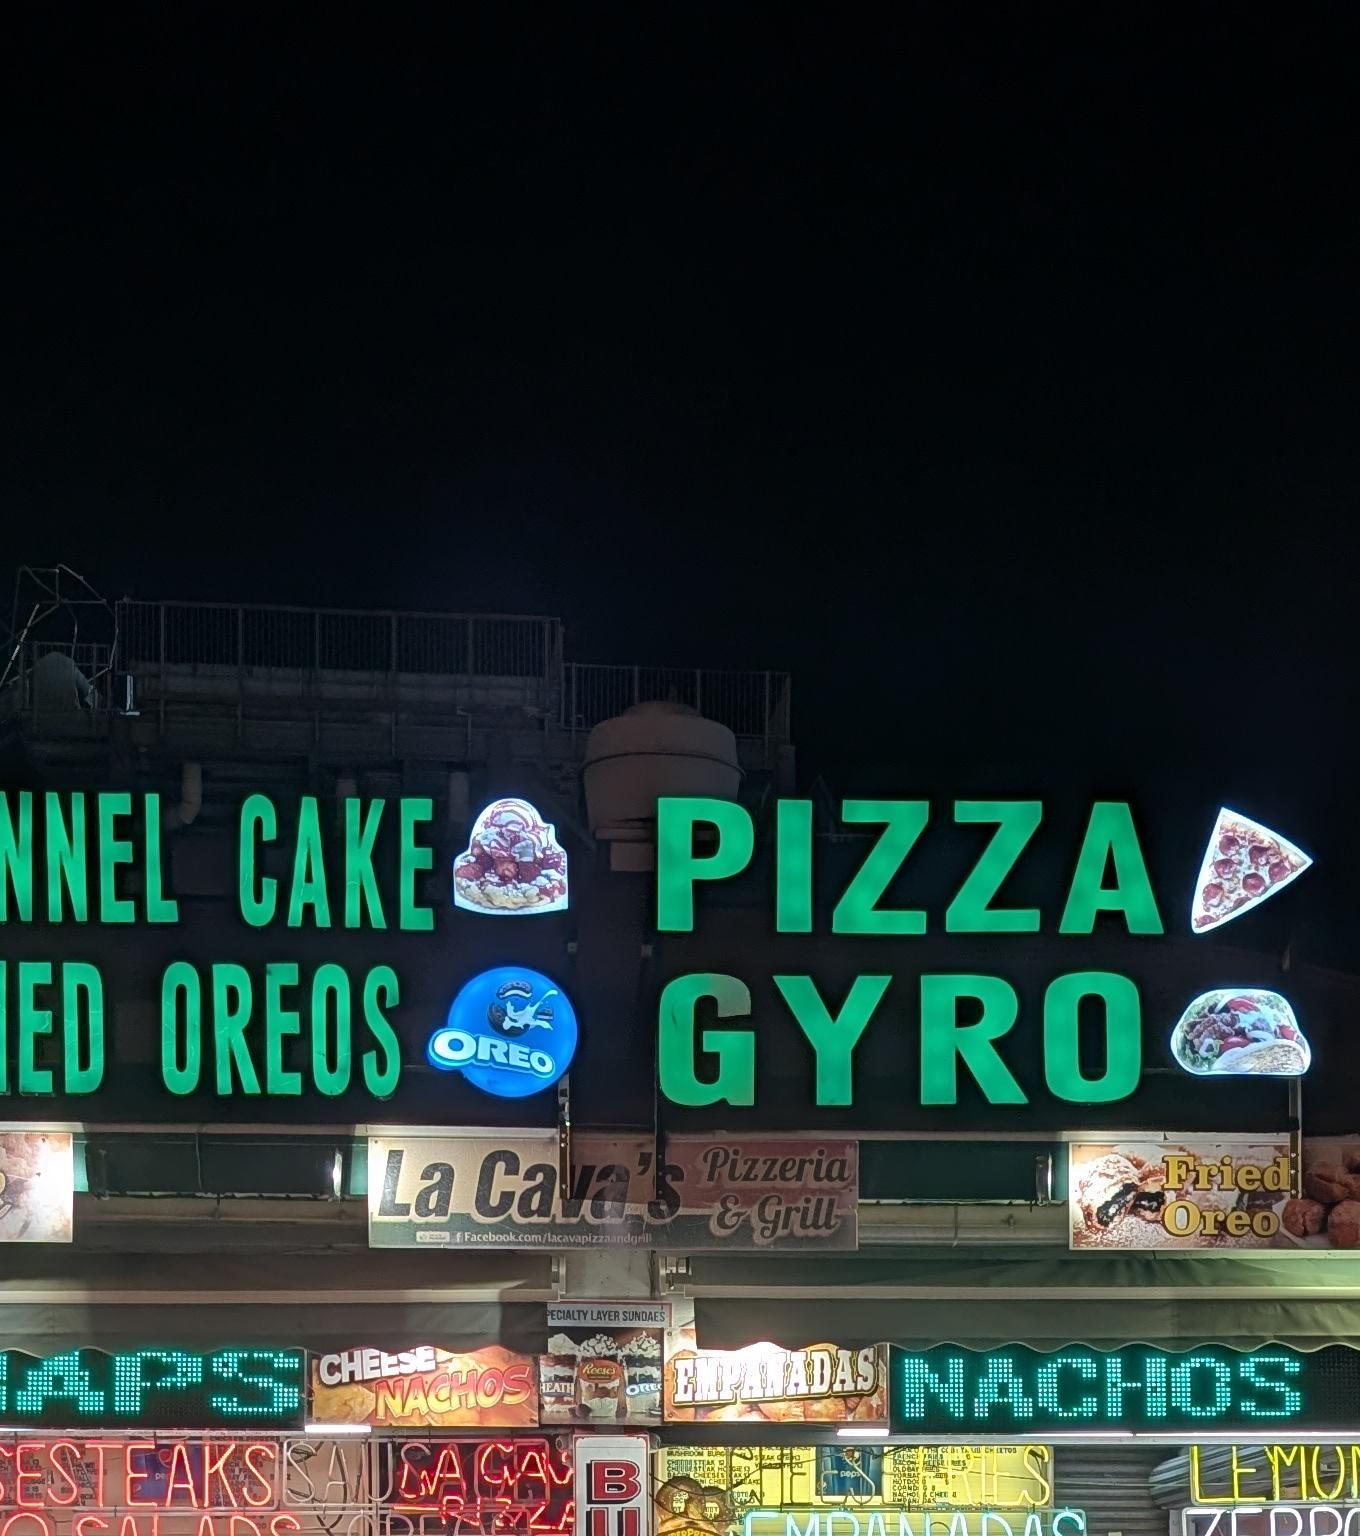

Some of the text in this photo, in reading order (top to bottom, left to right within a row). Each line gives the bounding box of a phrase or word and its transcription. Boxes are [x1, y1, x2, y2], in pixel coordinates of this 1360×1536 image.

[239, 793, 435, 931] CAKE
[656, 797, 1165, 935] PIZZA
[161, 961, 403, 1099] OREOS
[433, 1029, 555, 1076] OREO
[658, 970, 1142, 1107] GYRO
[378, 1149, 686, 1221] La Cava's
[702, 1146, 851, 1183] Pizzeria
[1161, 1153, 1292, 1194] Fried
[717, 1194, 839, 1239] & Grill
[1161, 1200, 1281, 1238] Oreo
[544, 1309, 666, 1323] PECIALTY LAYER SUNDAES
[319, 1345, 437, 1387] CHEESE
[373, 1363, 534, 1420] NACHOS
[673, 1346, 879, 1406] EMPANADAS
[902, 1355, 1302, 1418] NACHOS
